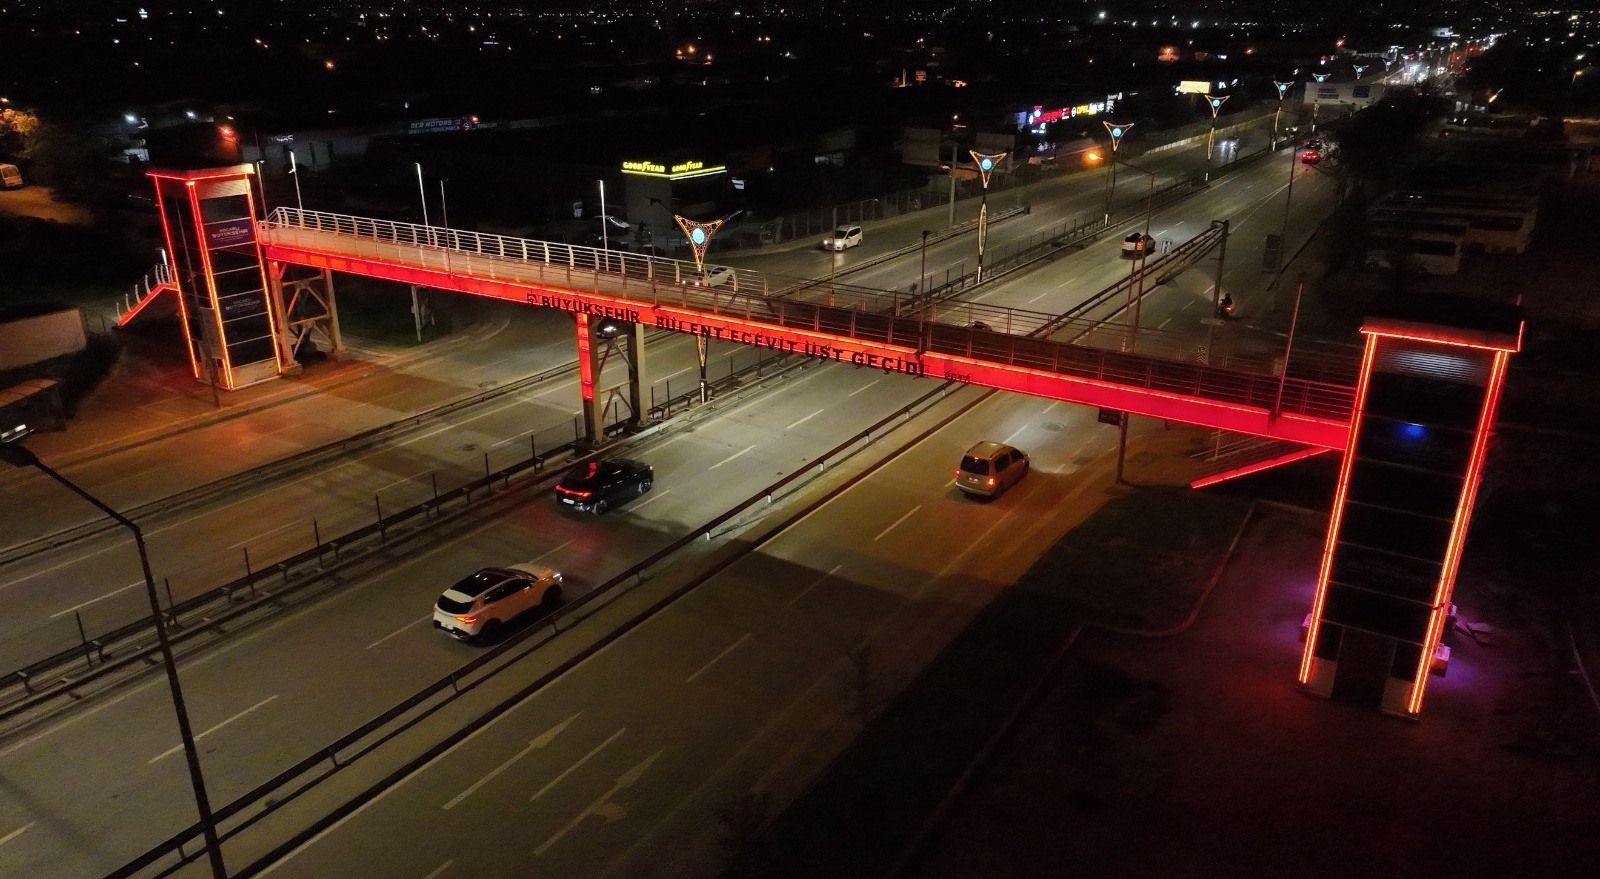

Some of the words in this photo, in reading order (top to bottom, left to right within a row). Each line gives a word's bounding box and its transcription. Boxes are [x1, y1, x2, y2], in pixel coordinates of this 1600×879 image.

[623, 161, 665, 172] GOODYEAR
[672, 161, 703, 172] GOODYEAR
[656, 316, 723, 340] BÜLENT
[731, 330, 797, 353] ECEVİT
[805, 341, 843, 363] ÜST
[852, 351, 925, 378] GEÇİDİ
